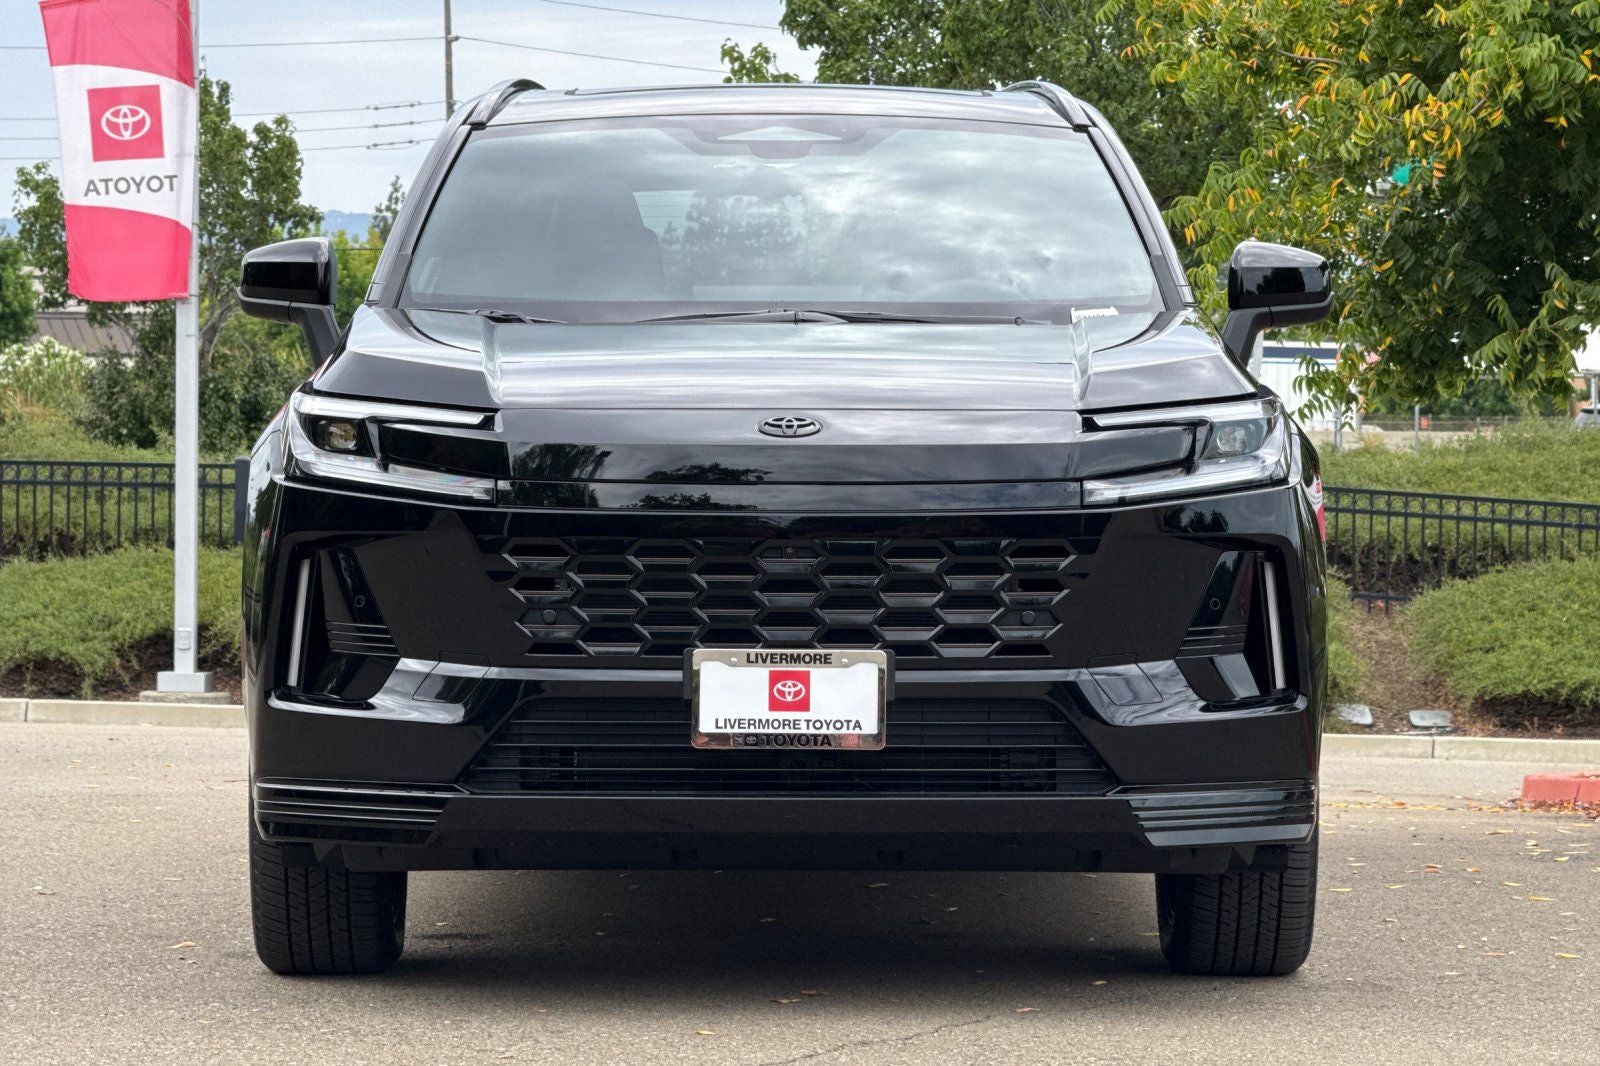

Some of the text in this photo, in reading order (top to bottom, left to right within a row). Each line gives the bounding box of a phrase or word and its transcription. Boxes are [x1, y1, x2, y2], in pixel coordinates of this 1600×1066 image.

[746, 653, 833, 665] LIVERMORE
[714, 718, 863, 731] LIVERMORE TOYOTA
[764, 733, 832, 747] TOYOTA
